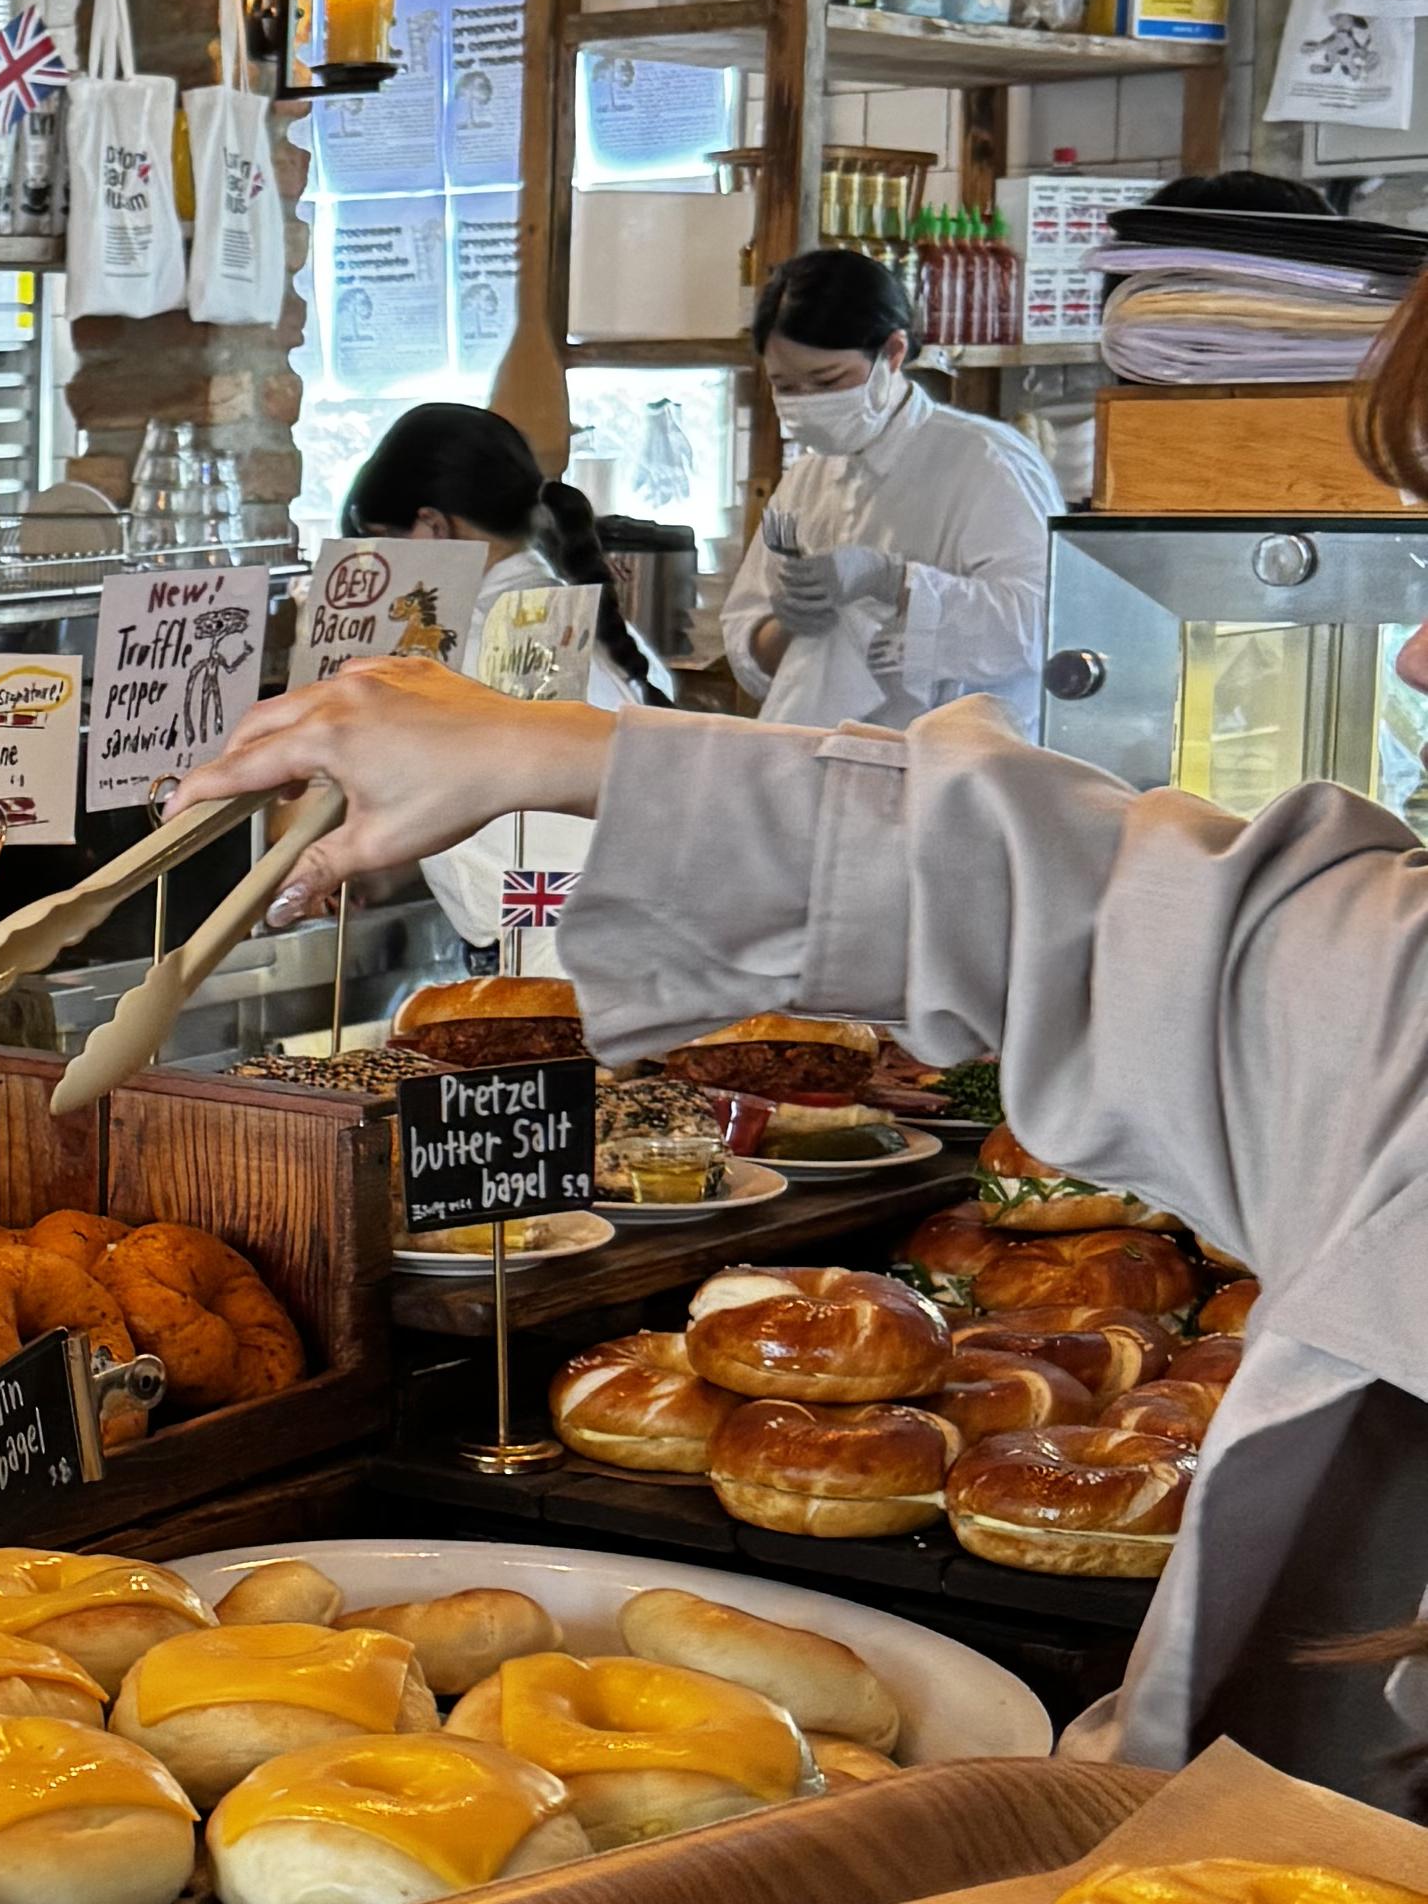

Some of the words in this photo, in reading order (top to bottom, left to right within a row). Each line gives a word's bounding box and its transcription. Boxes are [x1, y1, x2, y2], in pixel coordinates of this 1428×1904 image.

[148, 576, 224, 613] New!
[334, 565, 379, 601] BEST
[118, 617, 192, 671] Truffle
[311, 606, 376, 647] Bacon
[105, 680, 168, 720] pepper
[441, 1070, 546, 1123] Pretzel
[411, 1127, 502, 1178] butter
[513, 1111, 572, 1158] Salt
[482, 1160, 546, 1207] bagel
